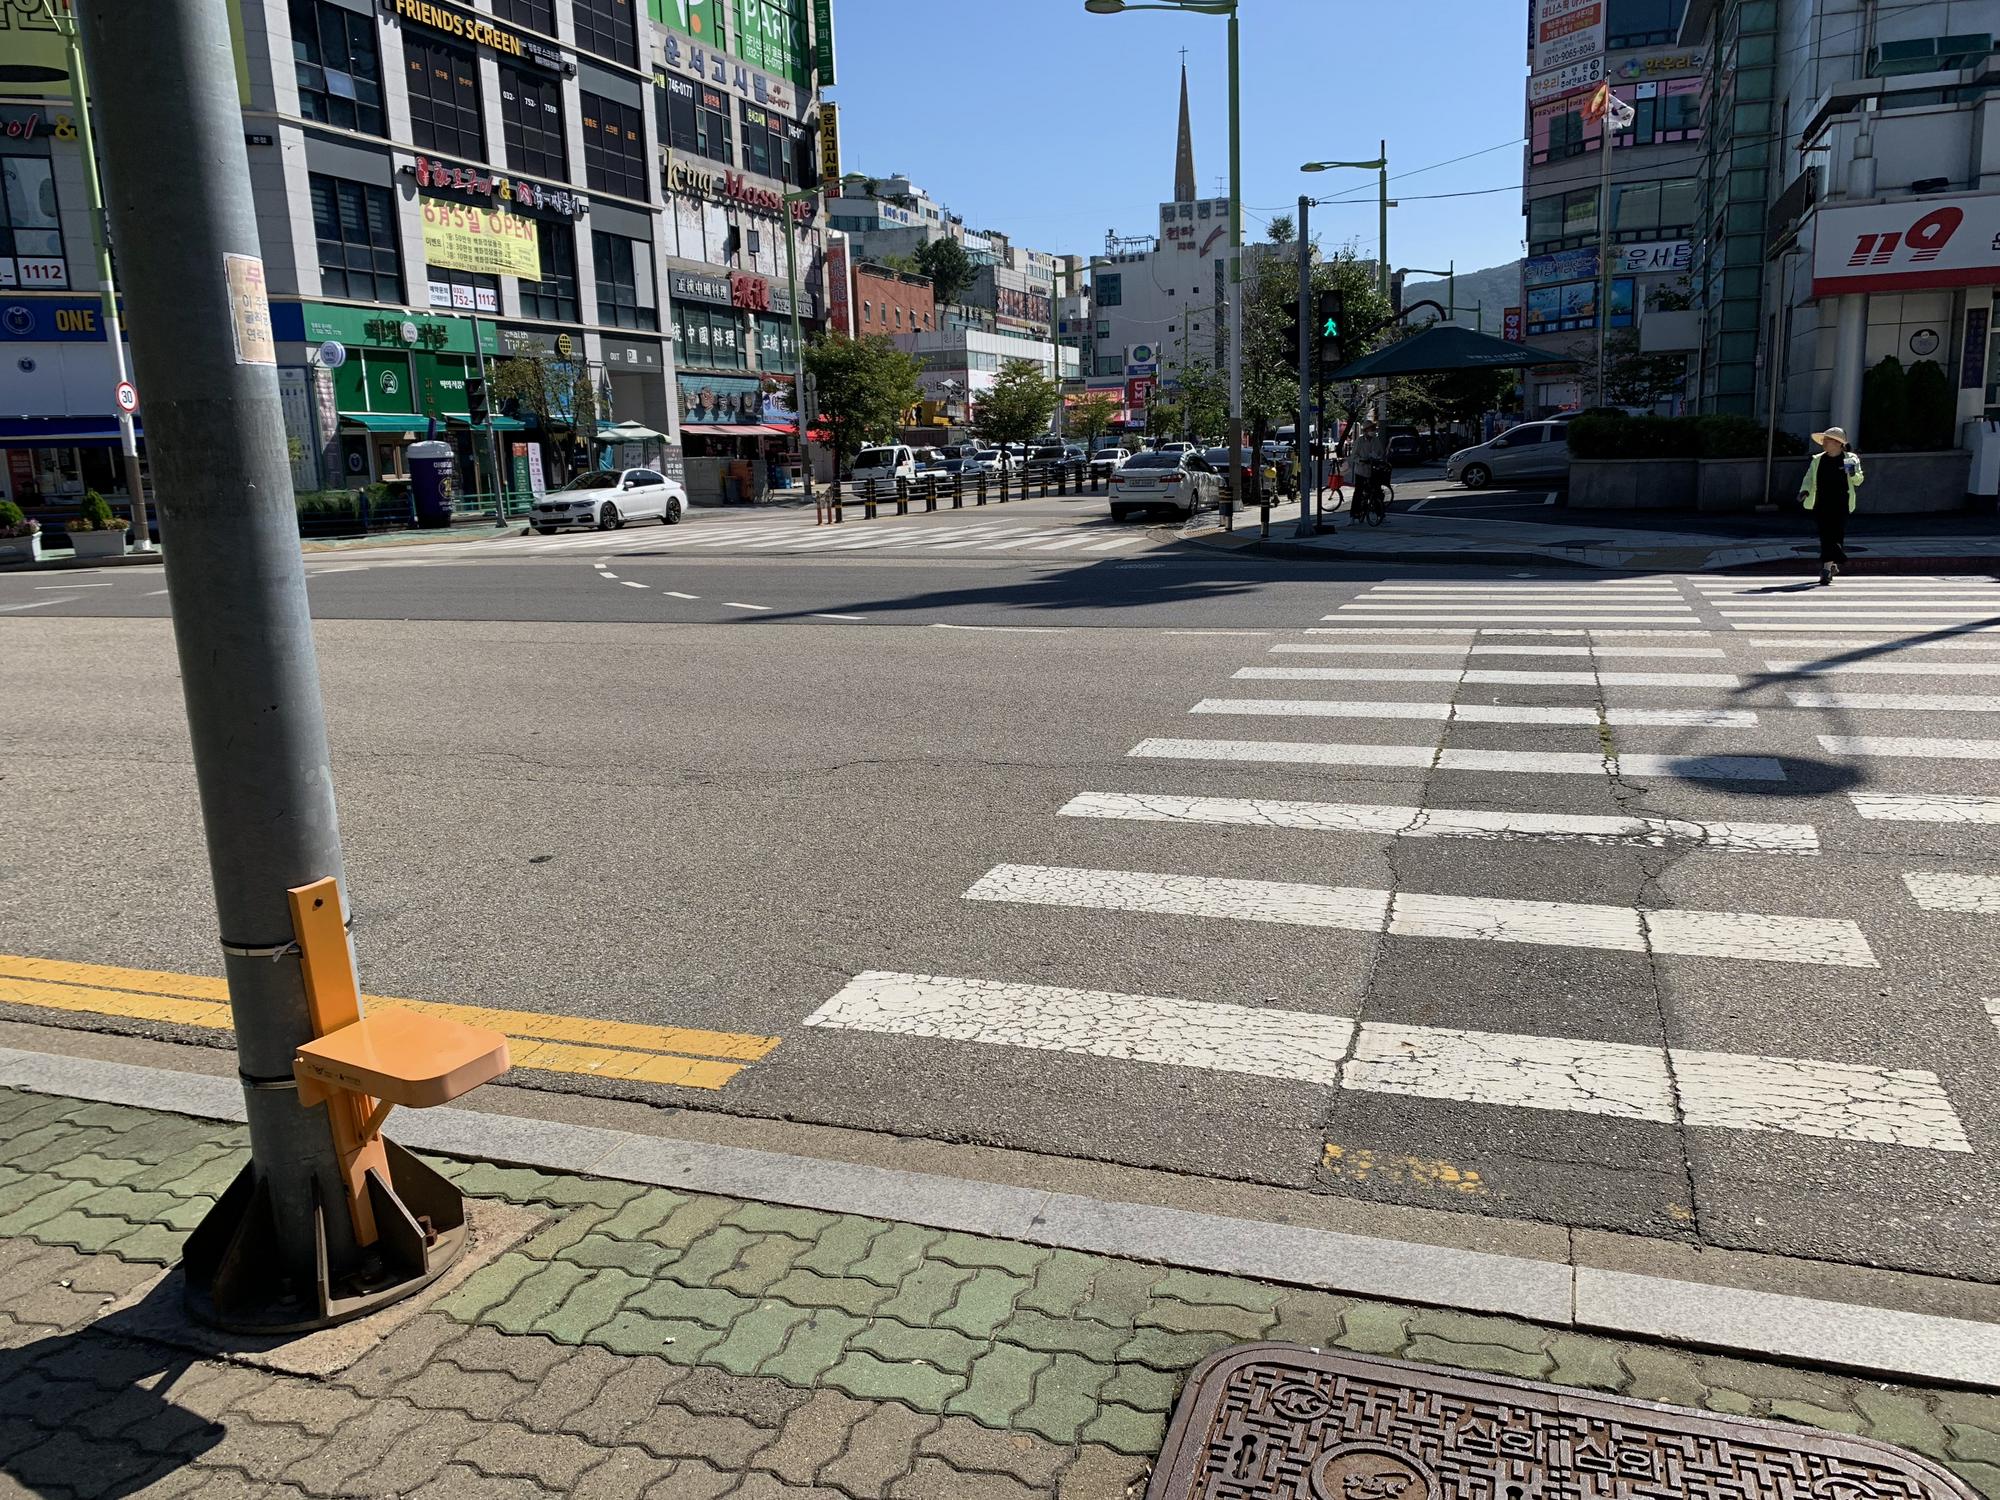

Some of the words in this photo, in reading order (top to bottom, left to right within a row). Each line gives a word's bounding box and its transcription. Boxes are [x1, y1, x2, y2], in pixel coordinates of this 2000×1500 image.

[396, 0, 463, 36] FRIENDS
[465, 18, 521, 56] SCREEN
[664, 34, 768, 104] 운서고시텔
[55, 113, 78, 140] &
[823, 113, 837, 178] 운서고시텔
[500, 178, 512, 201] &
[724, 169, 812, 222] Massge
[488, 212, 534, 242] OPEN
[1847, 207, 1964, 267] 119
[23, 265, 63, 279] 1112
[454, 294, 474, 306] 752-
[478, 293, 497, 306] 1112
[56, 309, 97, 332] ONE
[609, 352, 620, 360] OUT
[121, 390, 133, 403] 30
[1458, 1416, 1544, 1463] 삼화
[1575, 1436, 1662, 1483] 삼화
